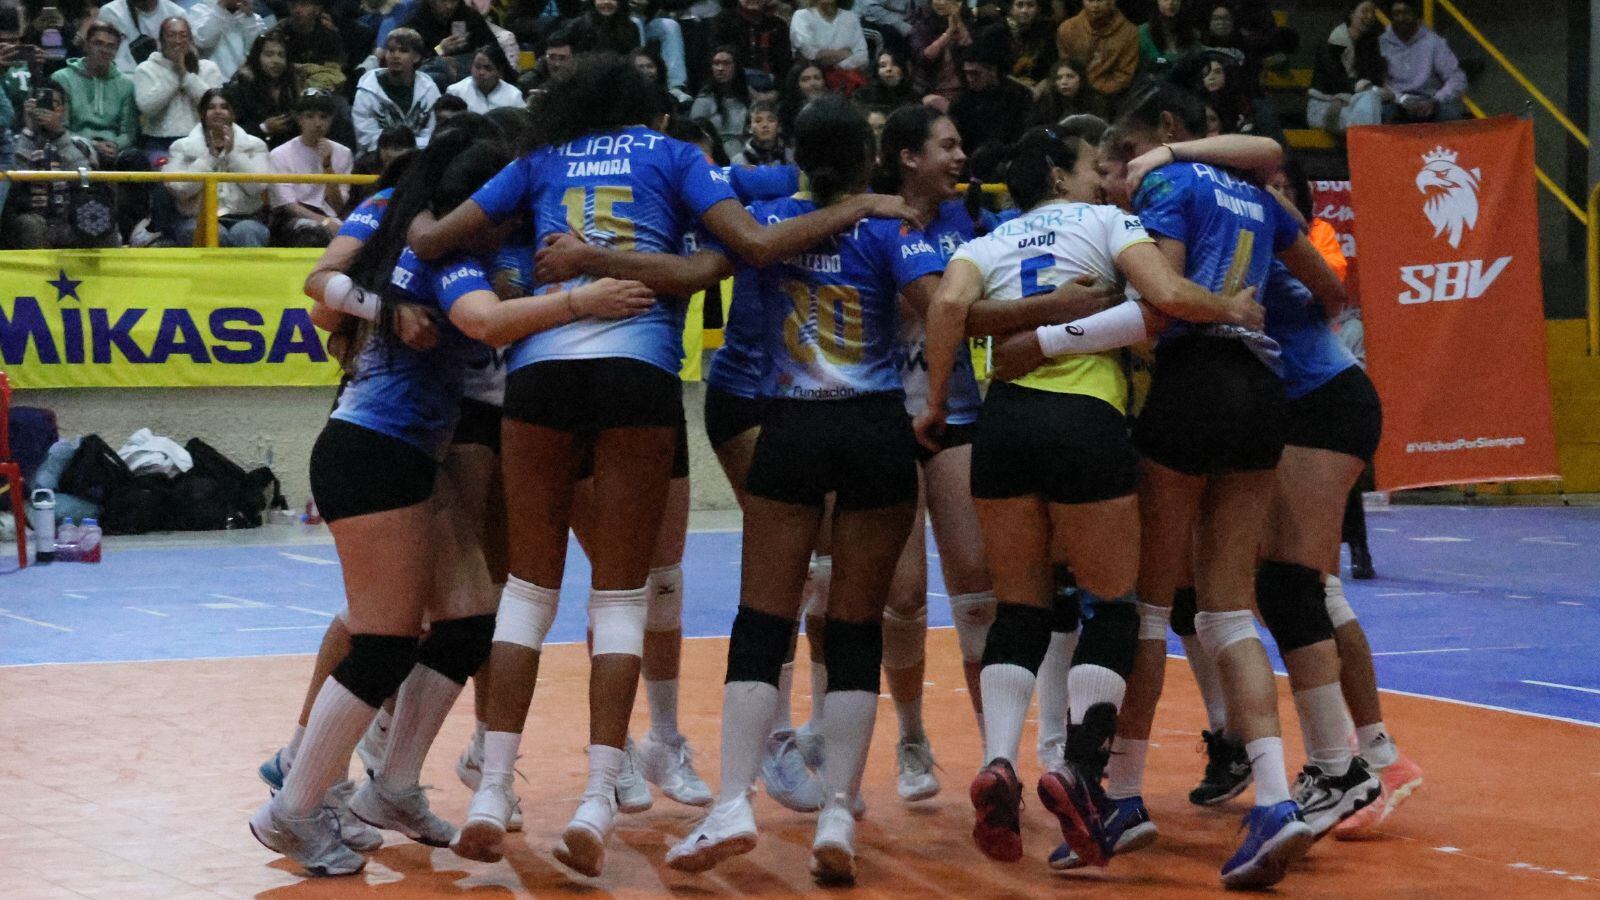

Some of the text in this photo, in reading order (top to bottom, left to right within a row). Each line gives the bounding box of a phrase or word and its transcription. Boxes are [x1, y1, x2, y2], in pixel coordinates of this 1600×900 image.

[567, 158, 631, 178] ZAMORA
[561, 185, 634, 251] 15
[1398, 256, 1513, 305] SBV
[1406, 436, 1525, 454] #VilchesPorSiempre
